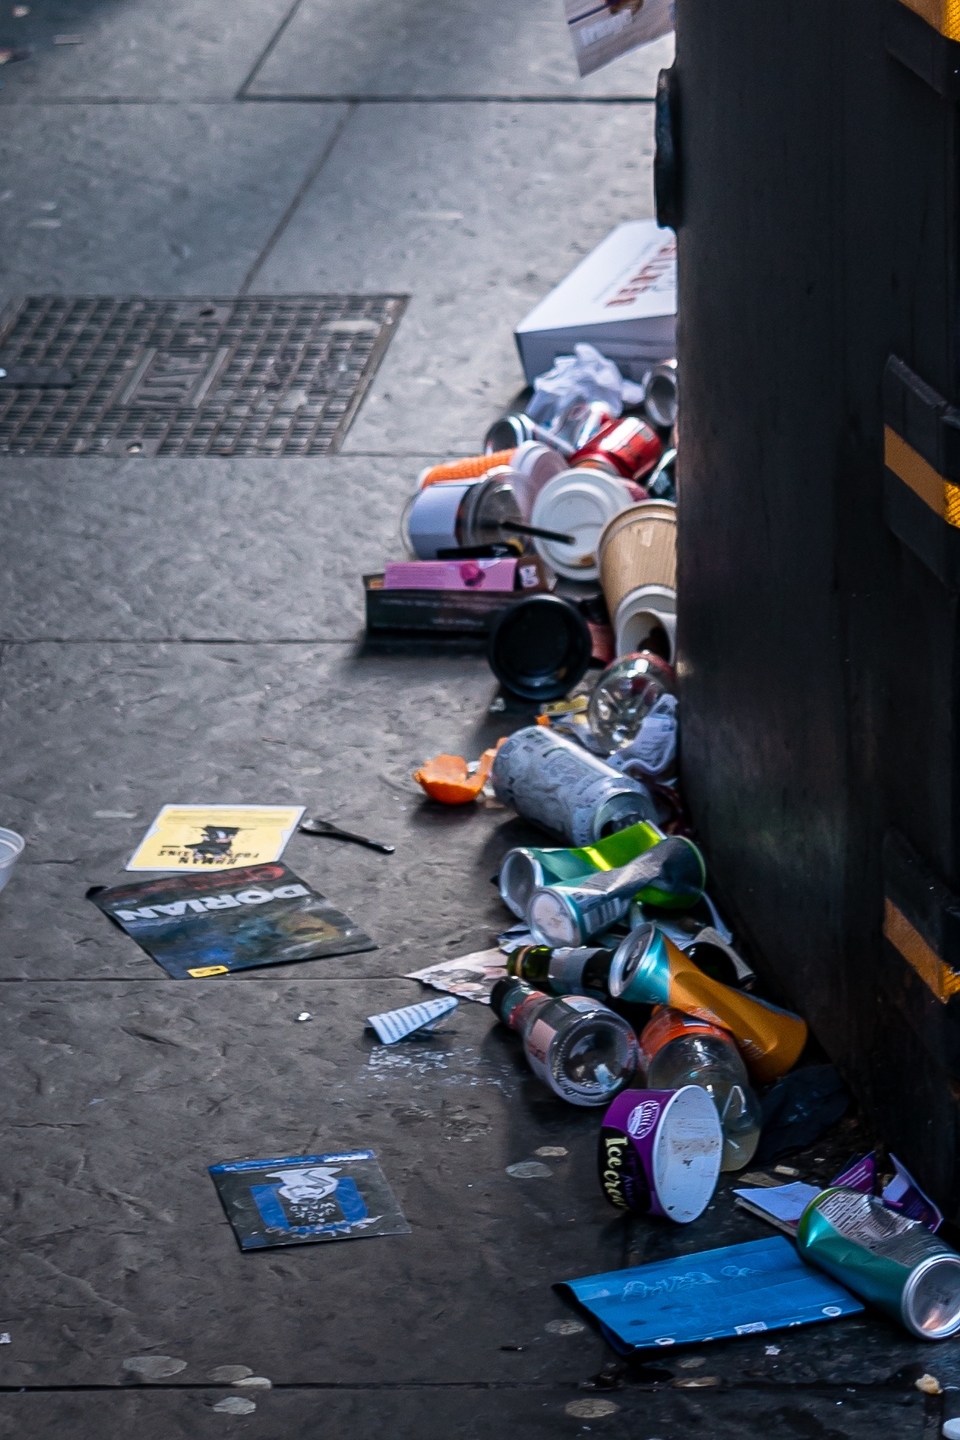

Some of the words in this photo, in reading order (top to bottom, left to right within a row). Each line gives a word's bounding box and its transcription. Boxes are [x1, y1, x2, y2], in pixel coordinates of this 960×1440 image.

[114, 883, 312, 922] DORIAN
[604, 1136, 629, 1169] Ice
[602, 1169, 632, 1213] crea
